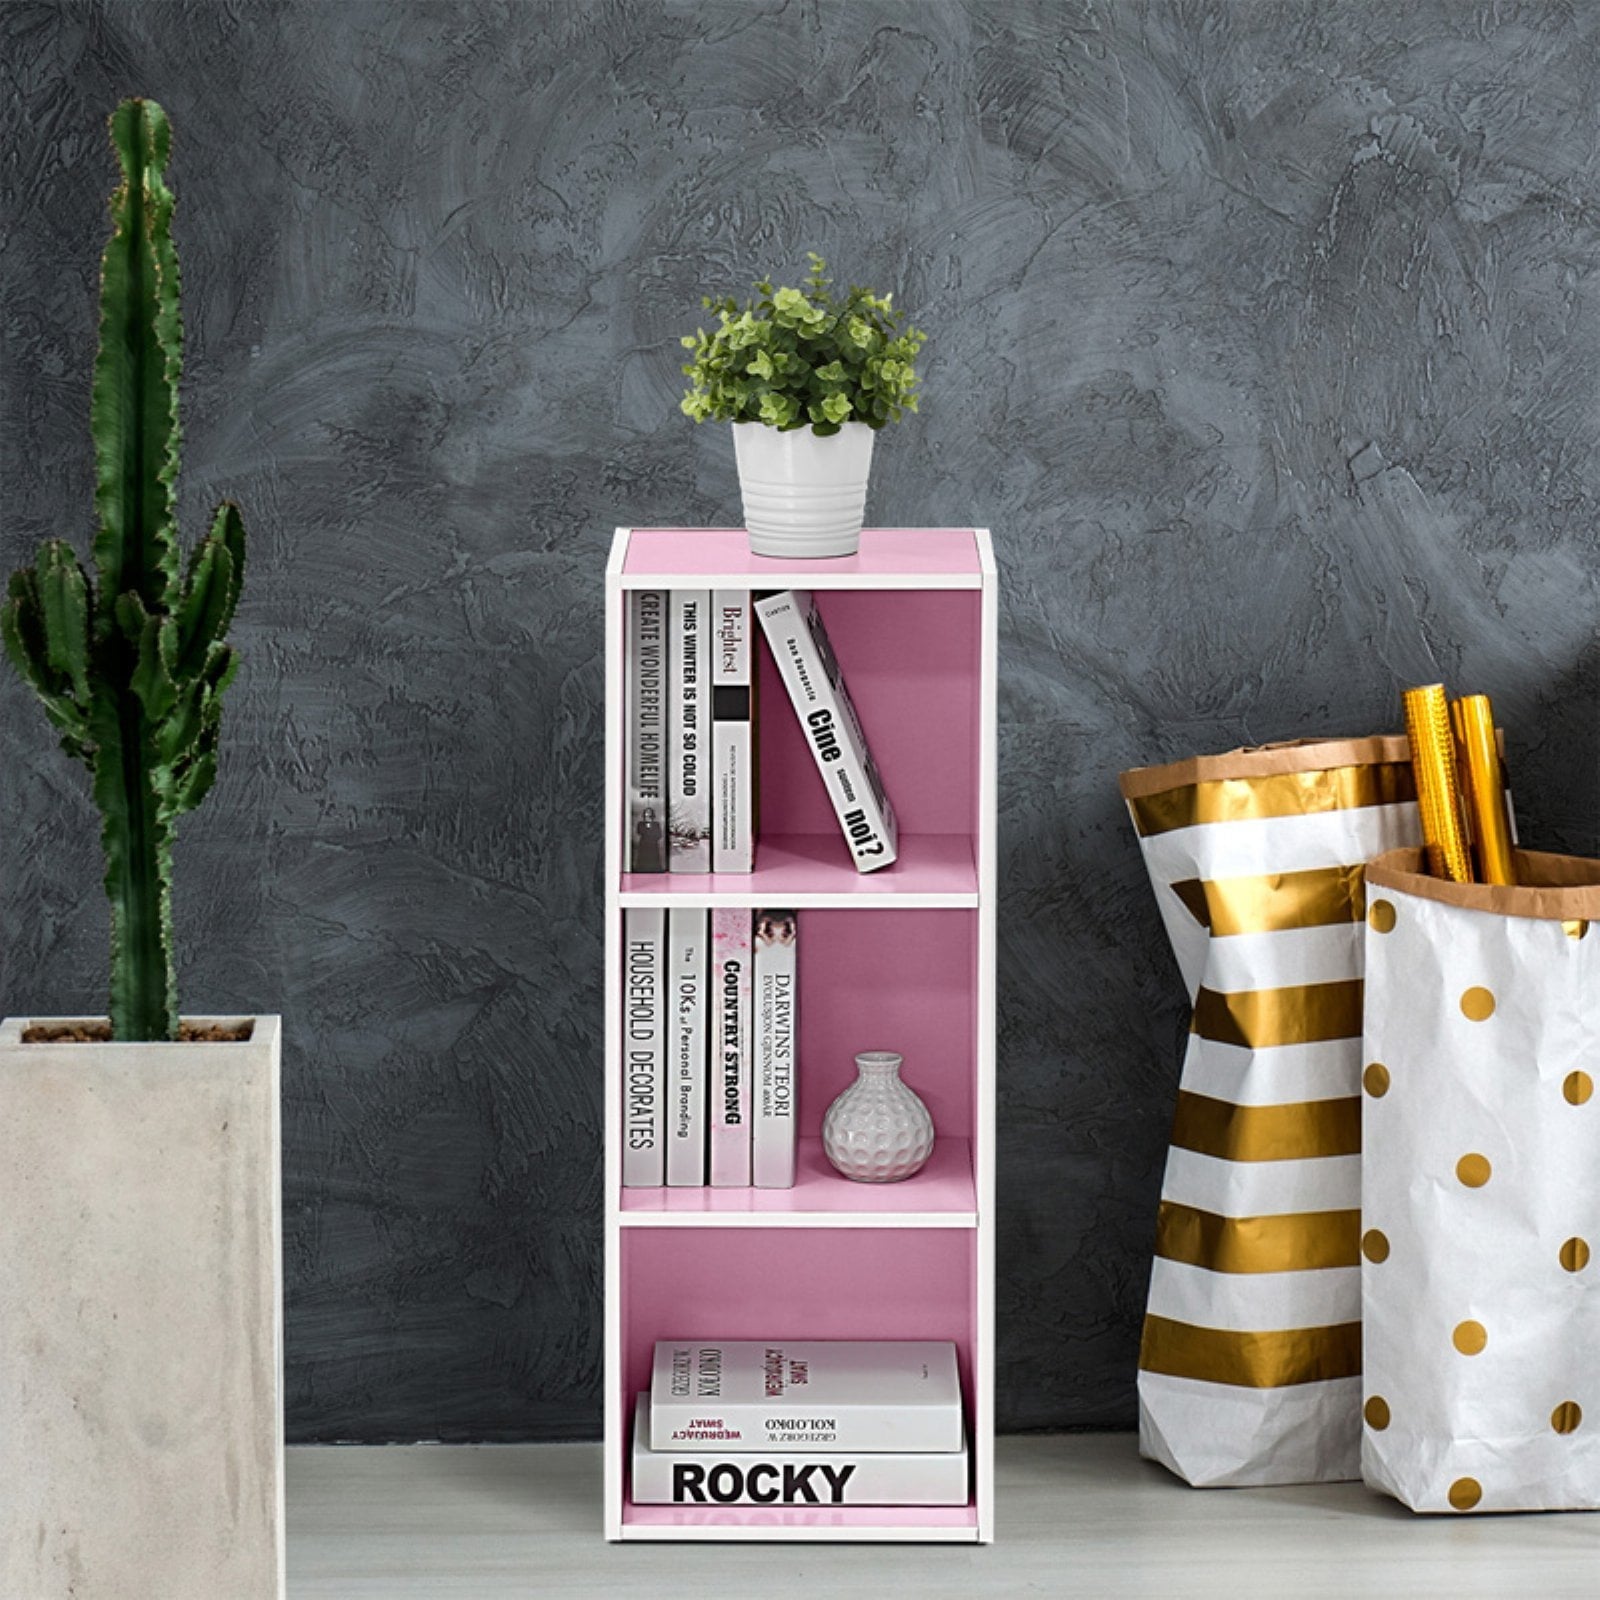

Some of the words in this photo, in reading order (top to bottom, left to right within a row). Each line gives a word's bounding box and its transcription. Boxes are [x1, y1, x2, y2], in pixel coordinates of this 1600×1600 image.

[640, 593, 660, 640] CREATE
[683, 602, 697, 631] THIS
[717, 607, 743, 673] Brightest
[683, 635, 697, 684] WINTER
[640, 646, 660, 728] WONDERFUL
[683, 687, 697, 700] IS
[683, 705, 697, 729] NOT
[683, 734, 697, 750] SO
[640, 733, 660, 798] HOMELIFE
[683, 755, 697, 796] COLOD
[807, 708, 842, 762] Cine
[844, 808, 884, 857] noi?
[685, 948, 694, 962] The
[628, 941, 655, 1040] HOUSEHOLD
[680, 974, 696, 1014] 10Ks
[724, 960, 741, 1047] COUNTRY
[775, 973, 790, 1058] DARWINS
[680, 1027, 693, 1081] Personal
[628, 1051, 655, 1150] DECORATES
[677, 1085, 692, 1138] Branding
[724, 1052, 742, 1124] STRONG
[775, 1064, 790, 1118] TEORI
[672, 1464, 855, 1504] ROCKY
